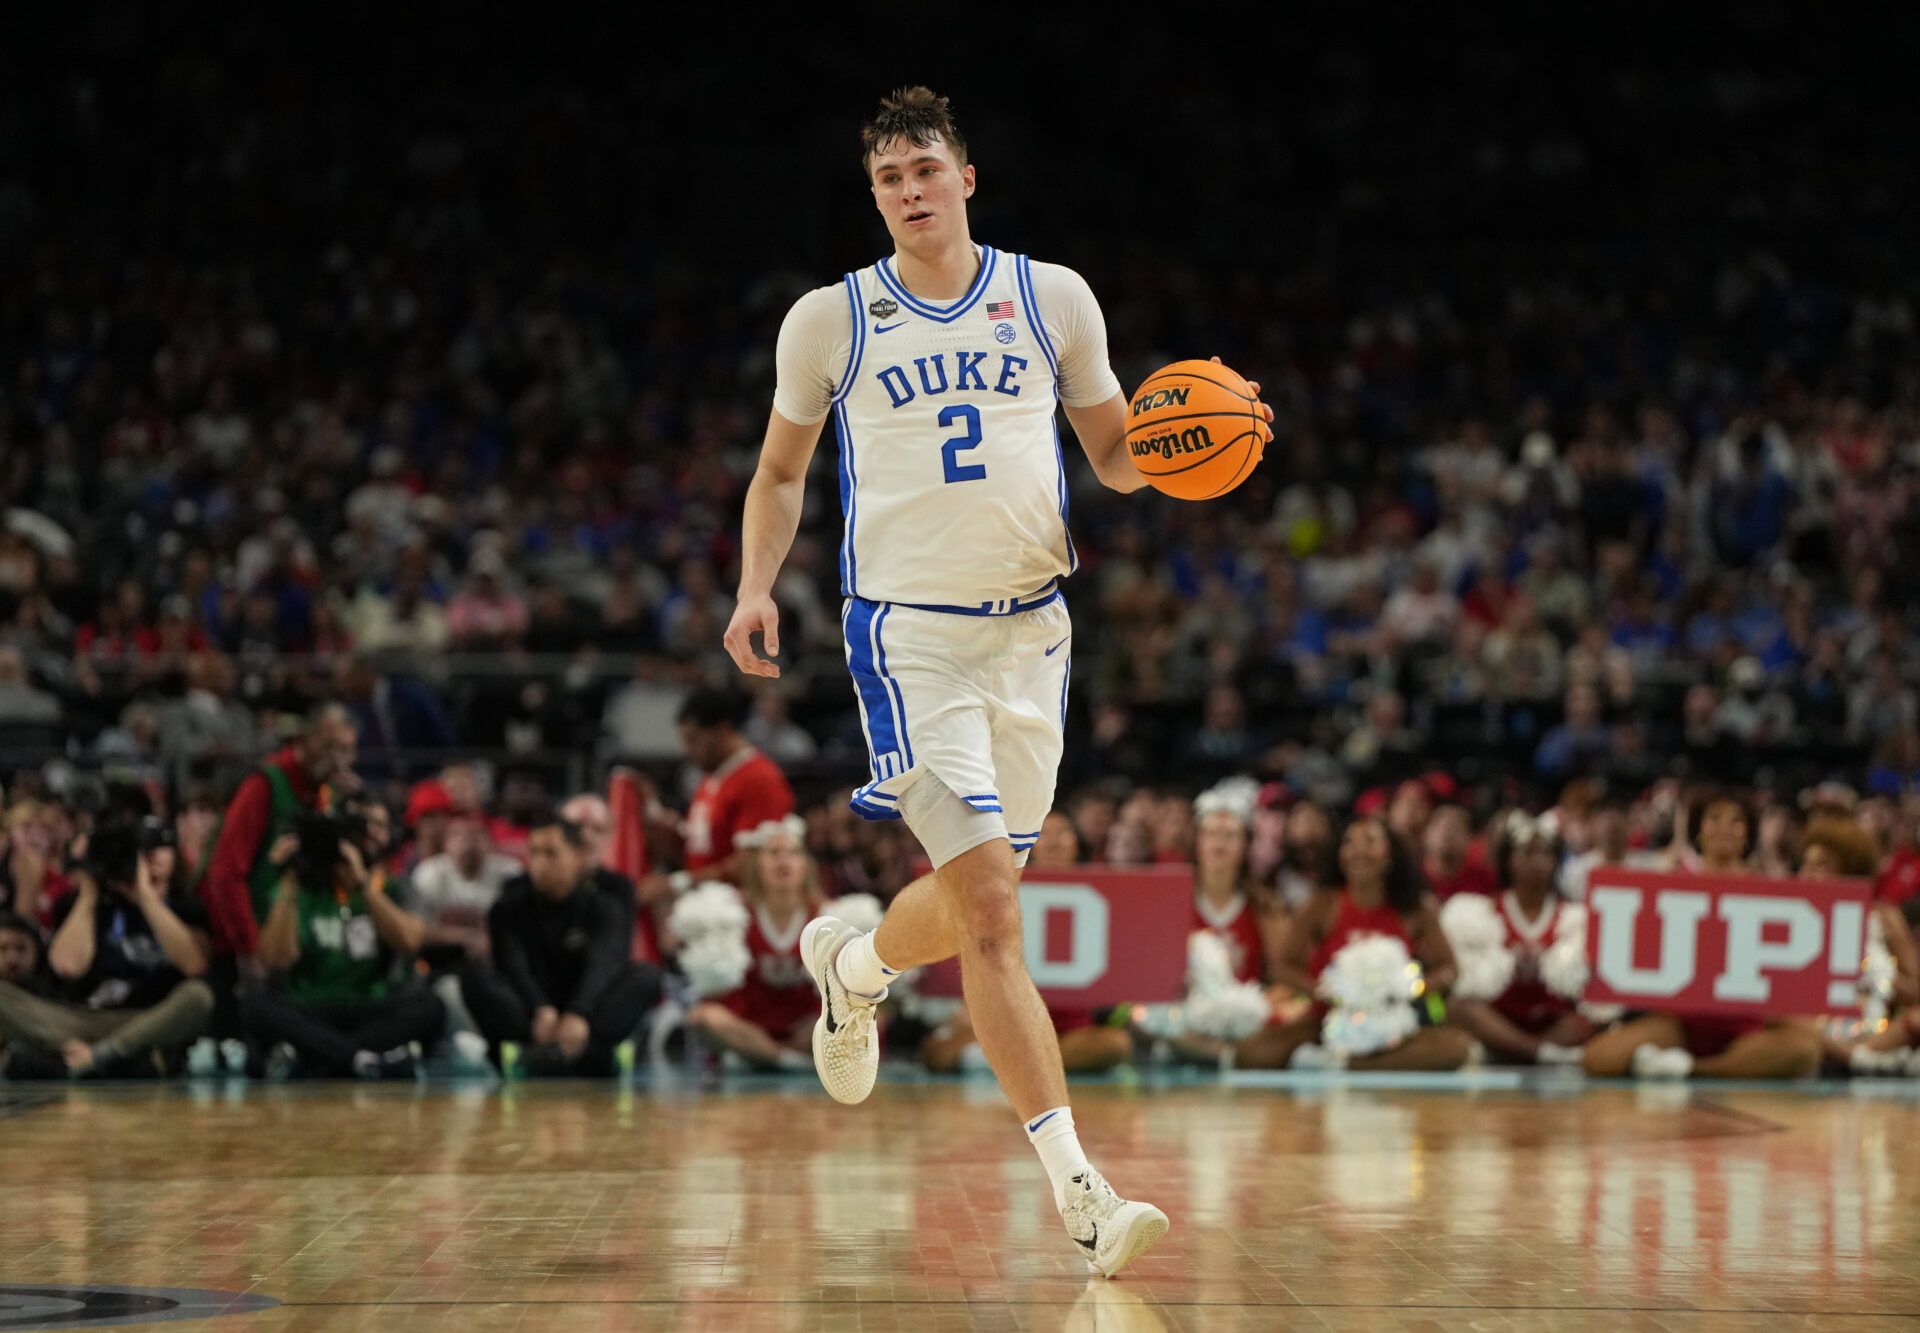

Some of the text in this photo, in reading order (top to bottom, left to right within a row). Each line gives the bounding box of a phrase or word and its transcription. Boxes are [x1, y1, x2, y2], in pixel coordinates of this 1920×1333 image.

[876, 352, 1028, 409] DUKE
[1133, 388, 1190, 417] NCAA
[938, 404, 987, 484] 2
[1130, 425, 1214, 459] Wilson
[1590, 886, 1864, 1007] UP!
